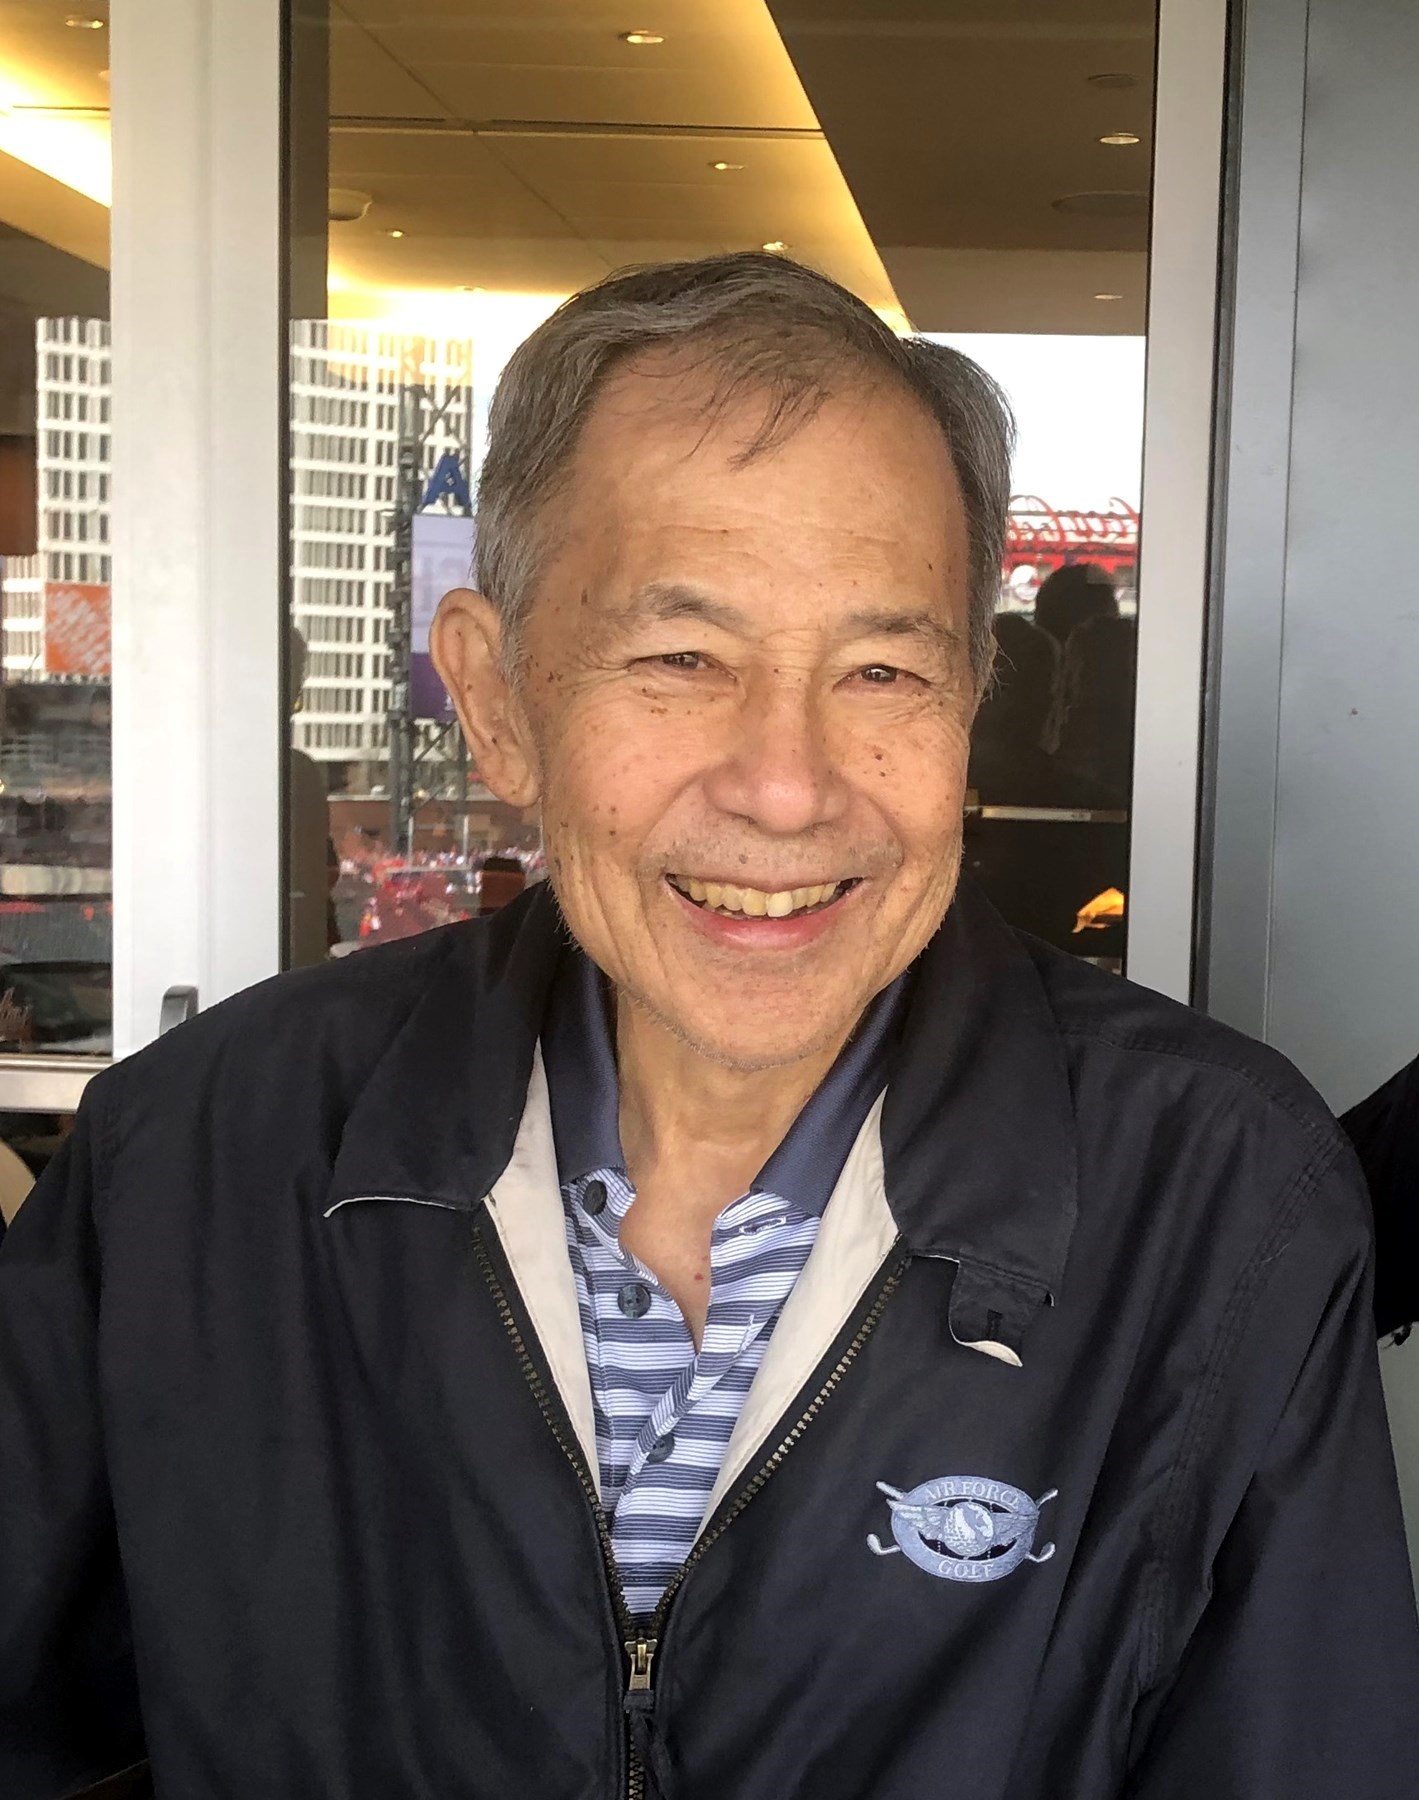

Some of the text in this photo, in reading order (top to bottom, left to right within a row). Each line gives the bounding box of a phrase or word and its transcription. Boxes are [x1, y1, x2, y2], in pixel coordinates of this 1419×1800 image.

[924, 1481, 1020, 1511] AIR FORCE
[938, 1560, 995, 1579] GOLF
